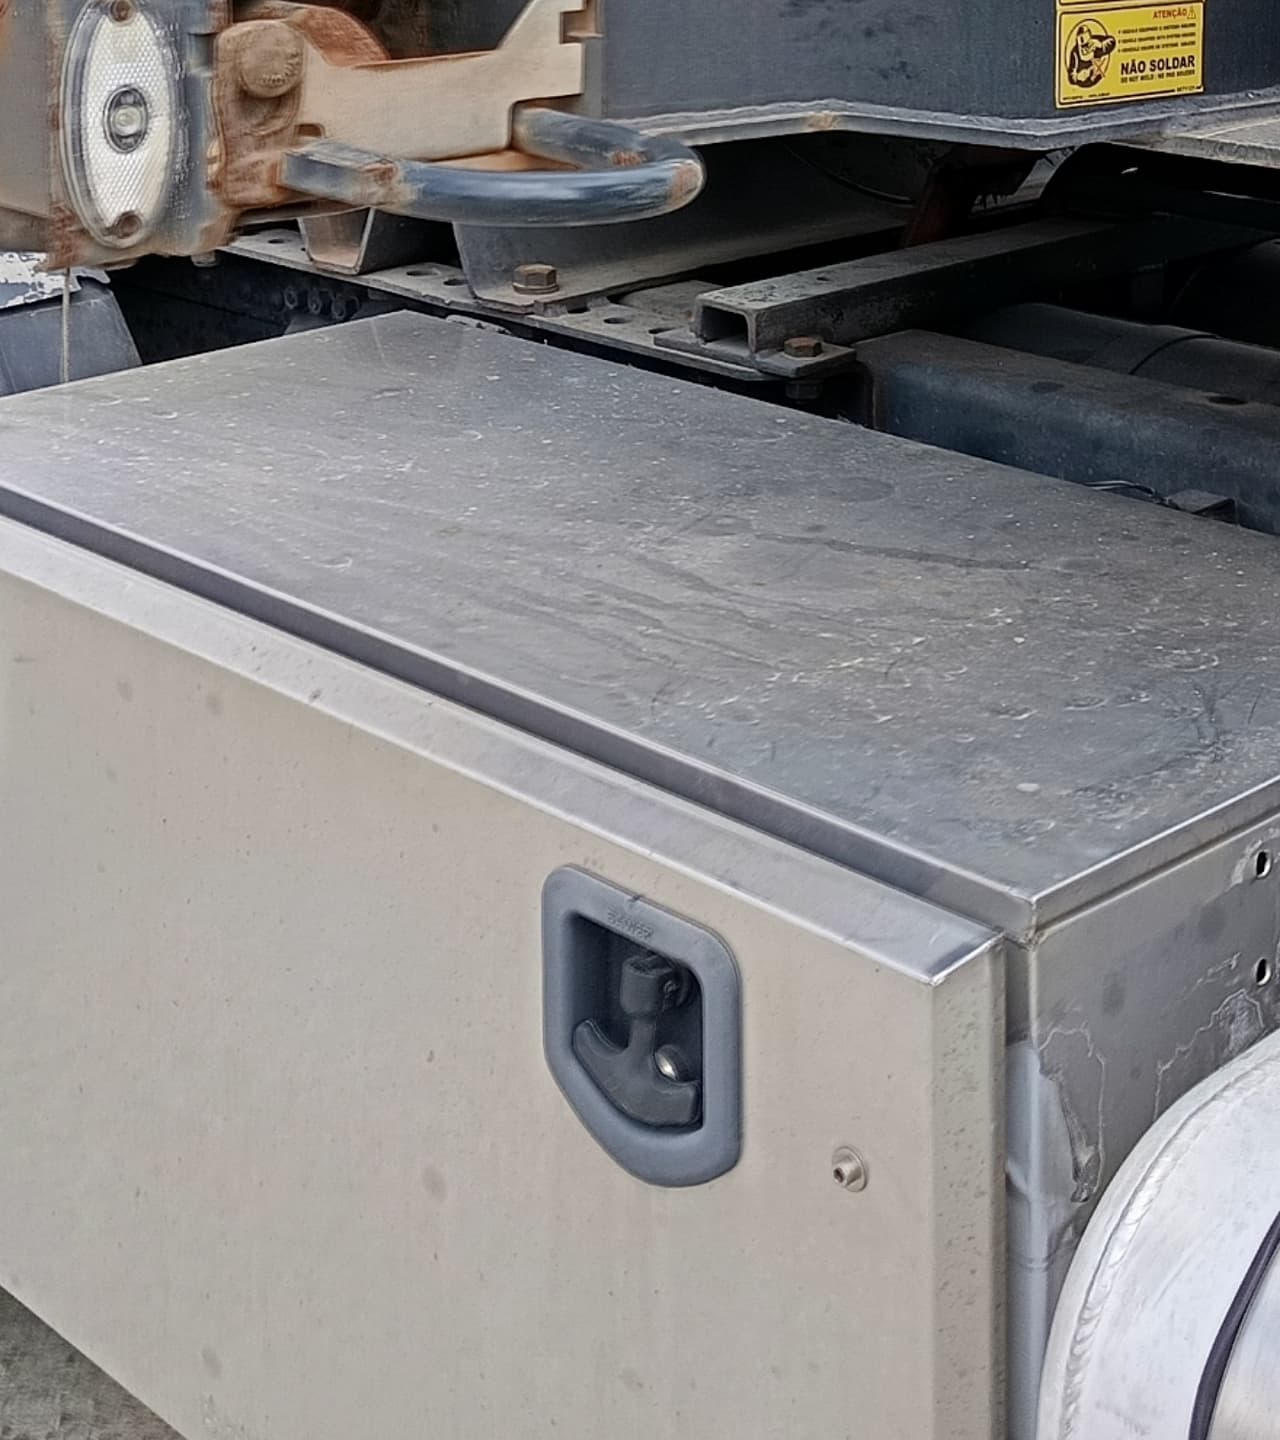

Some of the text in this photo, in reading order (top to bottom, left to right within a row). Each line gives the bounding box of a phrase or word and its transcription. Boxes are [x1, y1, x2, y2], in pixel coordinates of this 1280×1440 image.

[1152, 8, 1188, 20] ATENÇÃO
[1121, 55, 1195, 75] NÃO SOLDAR
